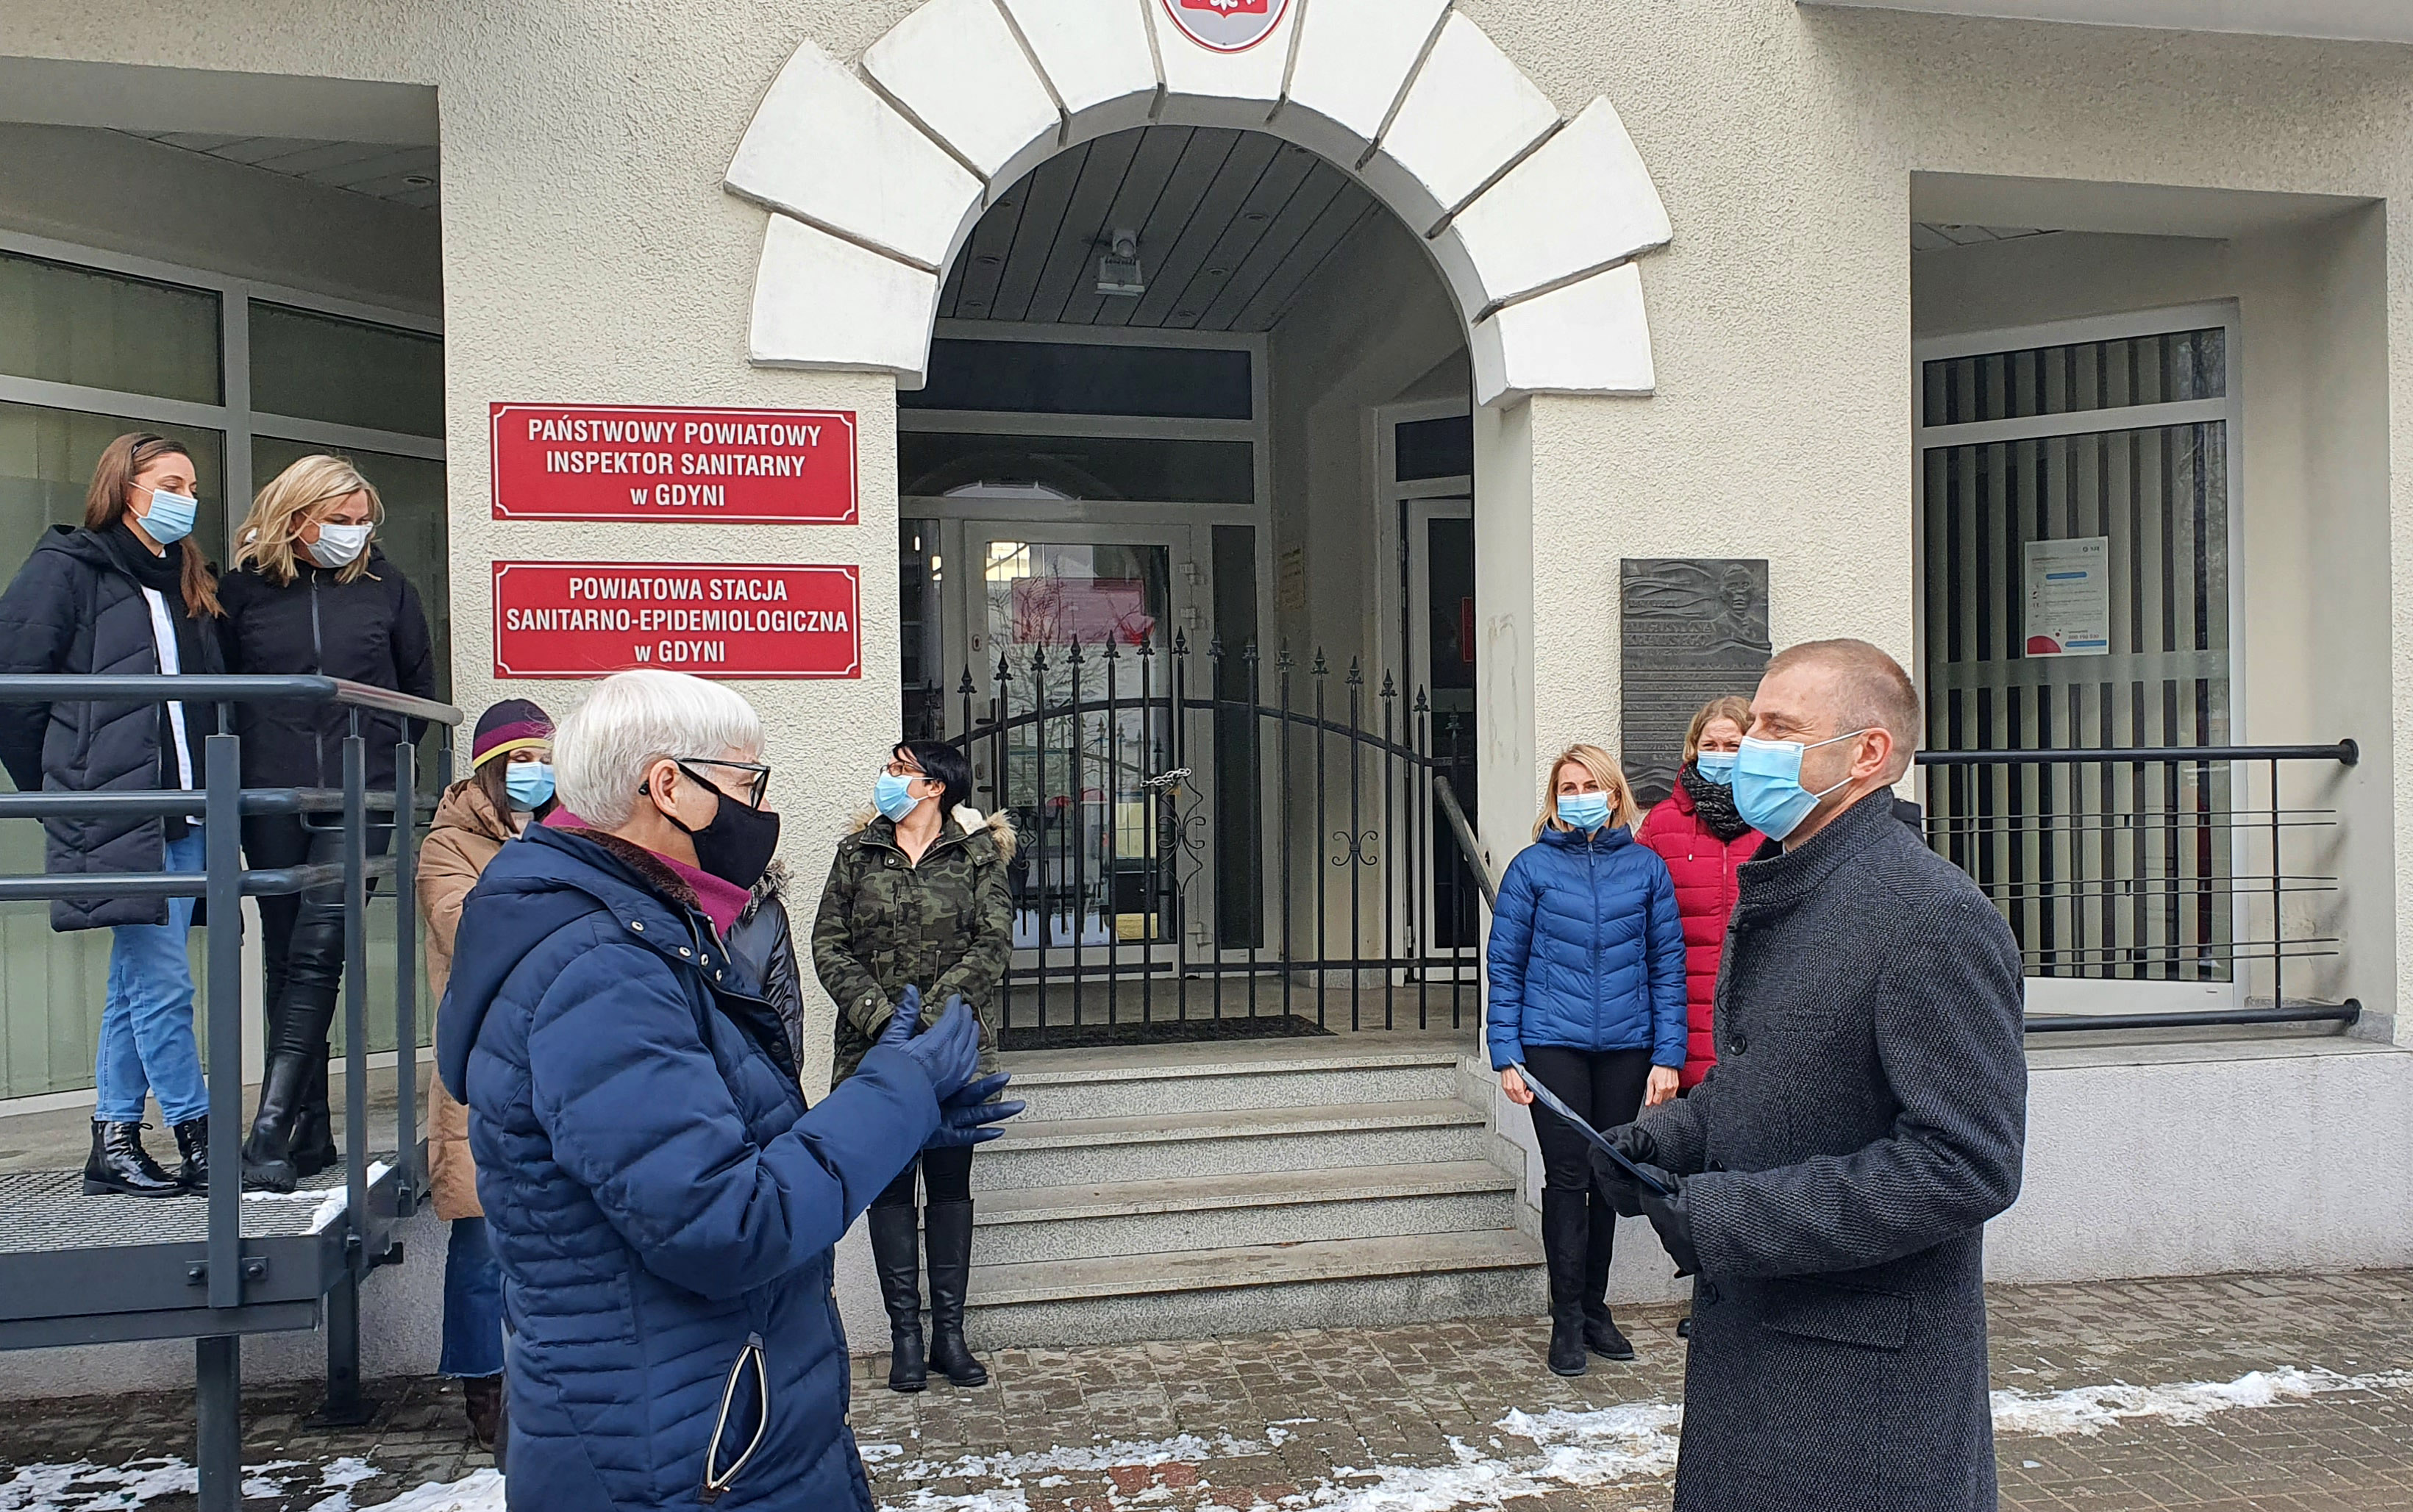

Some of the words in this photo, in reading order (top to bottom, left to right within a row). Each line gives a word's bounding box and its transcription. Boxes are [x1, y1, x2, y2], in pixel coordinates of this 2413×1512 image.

[529, 414, 677, 443] PAŃSTWOWY
[685, 422, 821, 446] POWIATOWY
[546, 450, 674, 474] INSPEKTOR
[681, 453, 805, 477] SANITARNY
[630, 488, 648, 505] w
[655, 483, 724, 507] GDYNI
[569, 577, 703, 600] POWIATOWA
[710, 578, 788, 601] STACJA
[507, 608, 849, 632] SANITARNO-EPIDEMIOLOGICZNA
[634, 645, 652, 662] w
[658, 640, 725, 663] GDYNI
